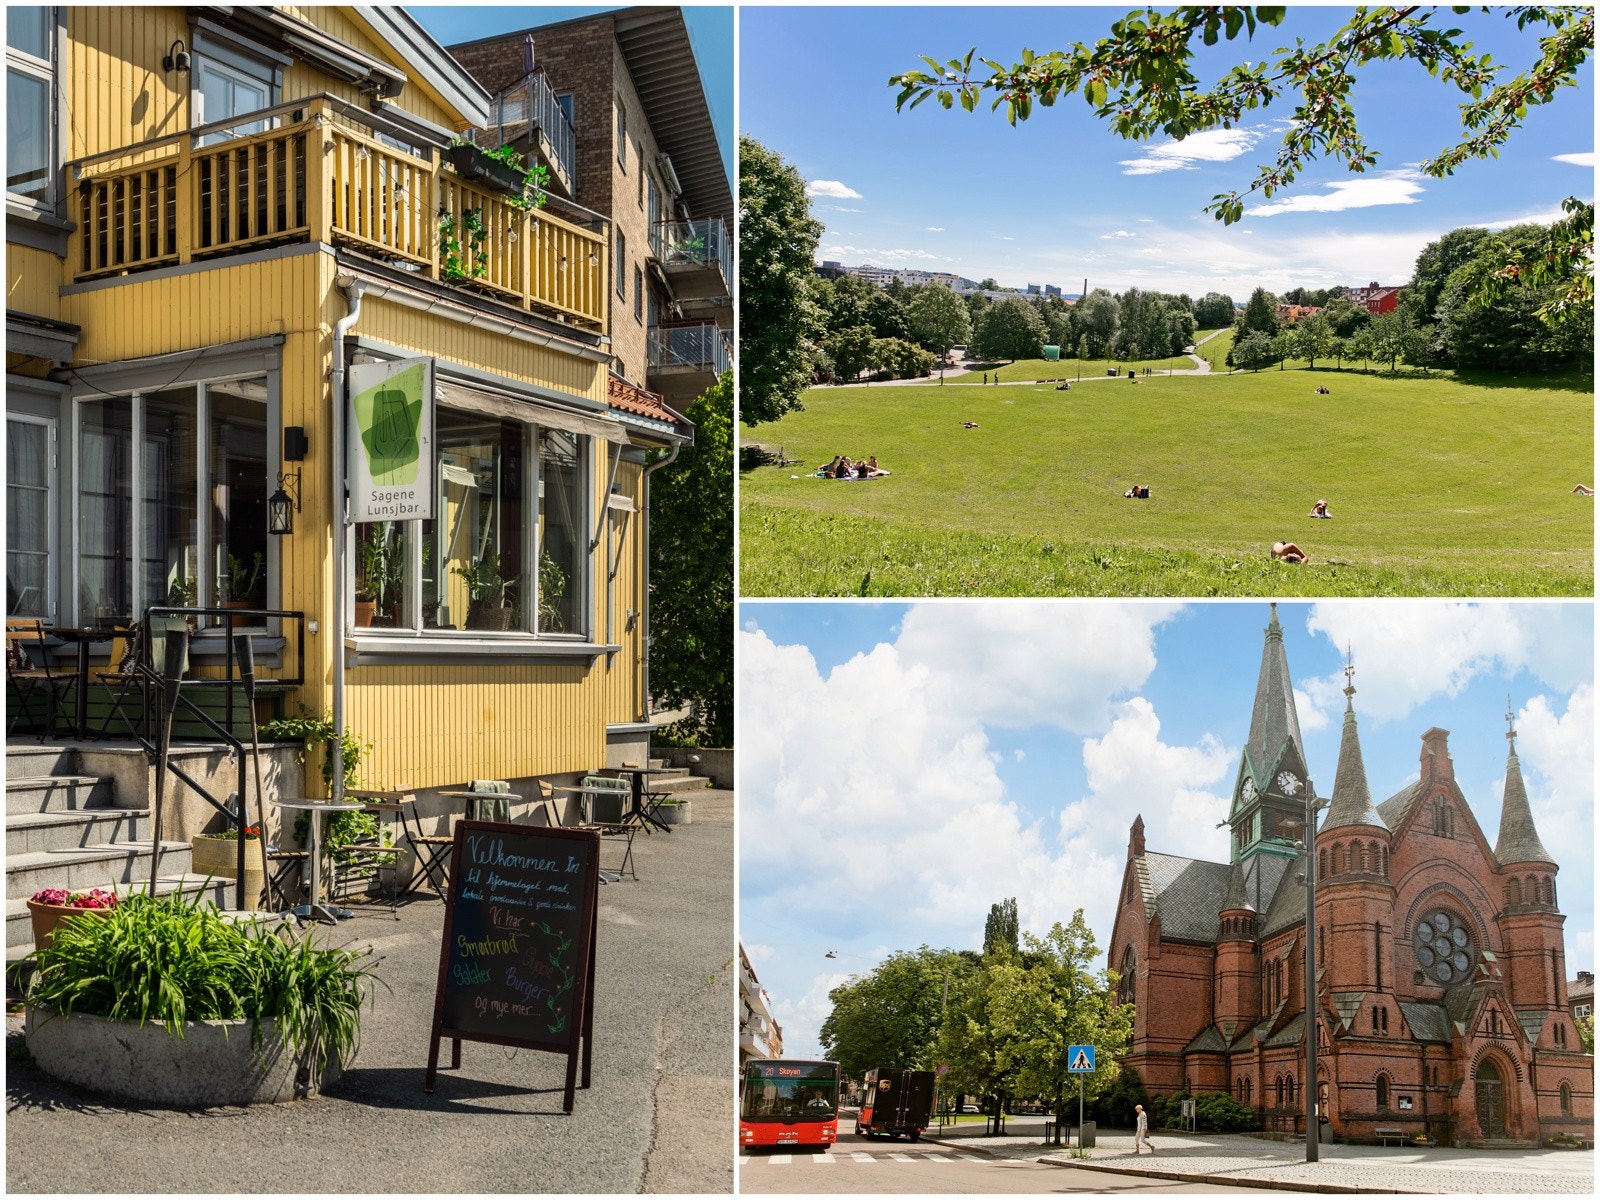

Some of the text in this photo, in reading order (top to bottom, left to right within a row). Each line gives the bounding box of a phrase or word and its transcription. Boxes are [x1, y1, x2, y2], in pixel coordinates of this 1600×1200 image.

[371, 490, 415, 503] Sagene
[367, 503, 419, 517] Lunsjbar
[467, 835, 559, 872] Velkommen
[465, 868, 480, 884] til
[486, 872, 541, 893] hjemmelaget
[489, 906, 525, 927] Vi har
[505, 966, 550, 1003] Burger
[491, 1000, 509, 1019] mye
[765, 1067, 801, 1077] 20 Skøyen
